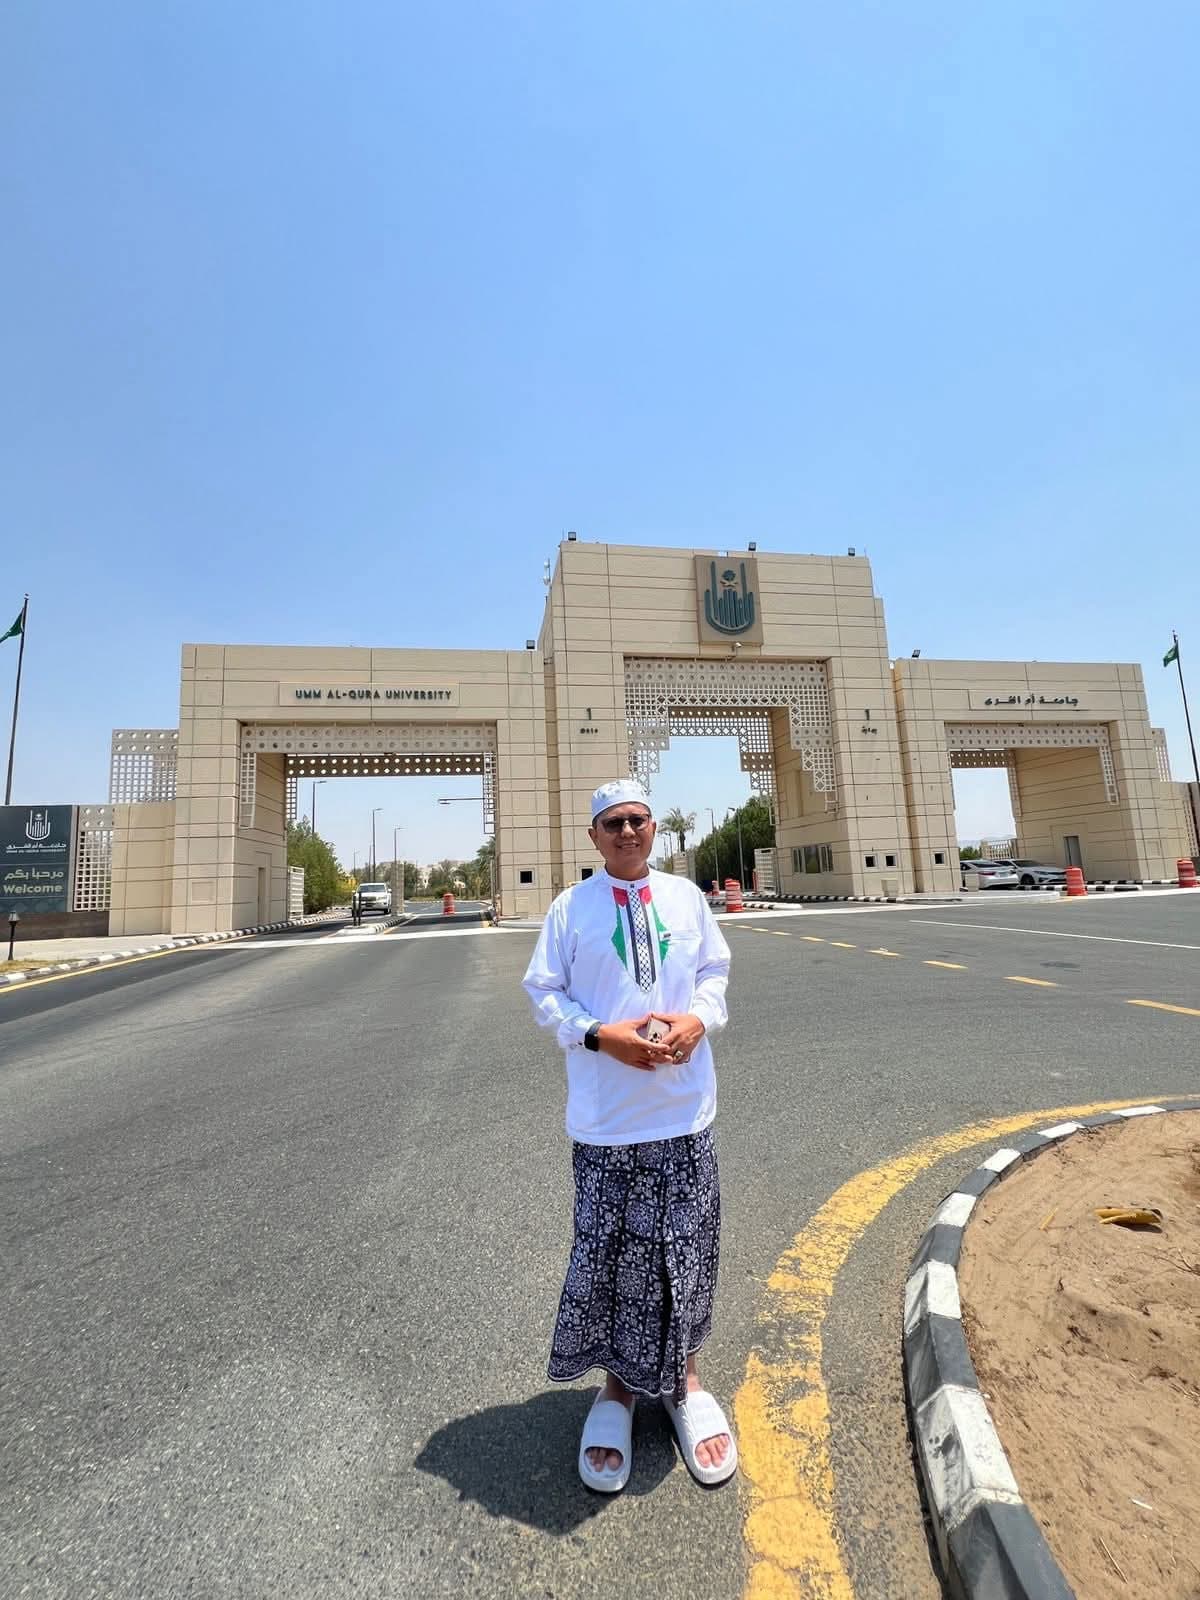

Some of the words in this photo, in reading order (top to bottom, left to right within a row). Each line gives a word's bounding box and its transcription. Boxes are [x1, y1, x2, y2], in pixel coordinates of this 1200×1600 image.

[295, 690, 321, 699] UMM
[327, 690, 380, 700] AL-QURA
[386, 690, 451, 700] UNIVERSITY
[1039, 696, 1078, 706] جامعة
[5, 869, 29, 881] بكم
[32, 867, 64, 880] مرحبا
[3, 884, 63, 894] Welcome
